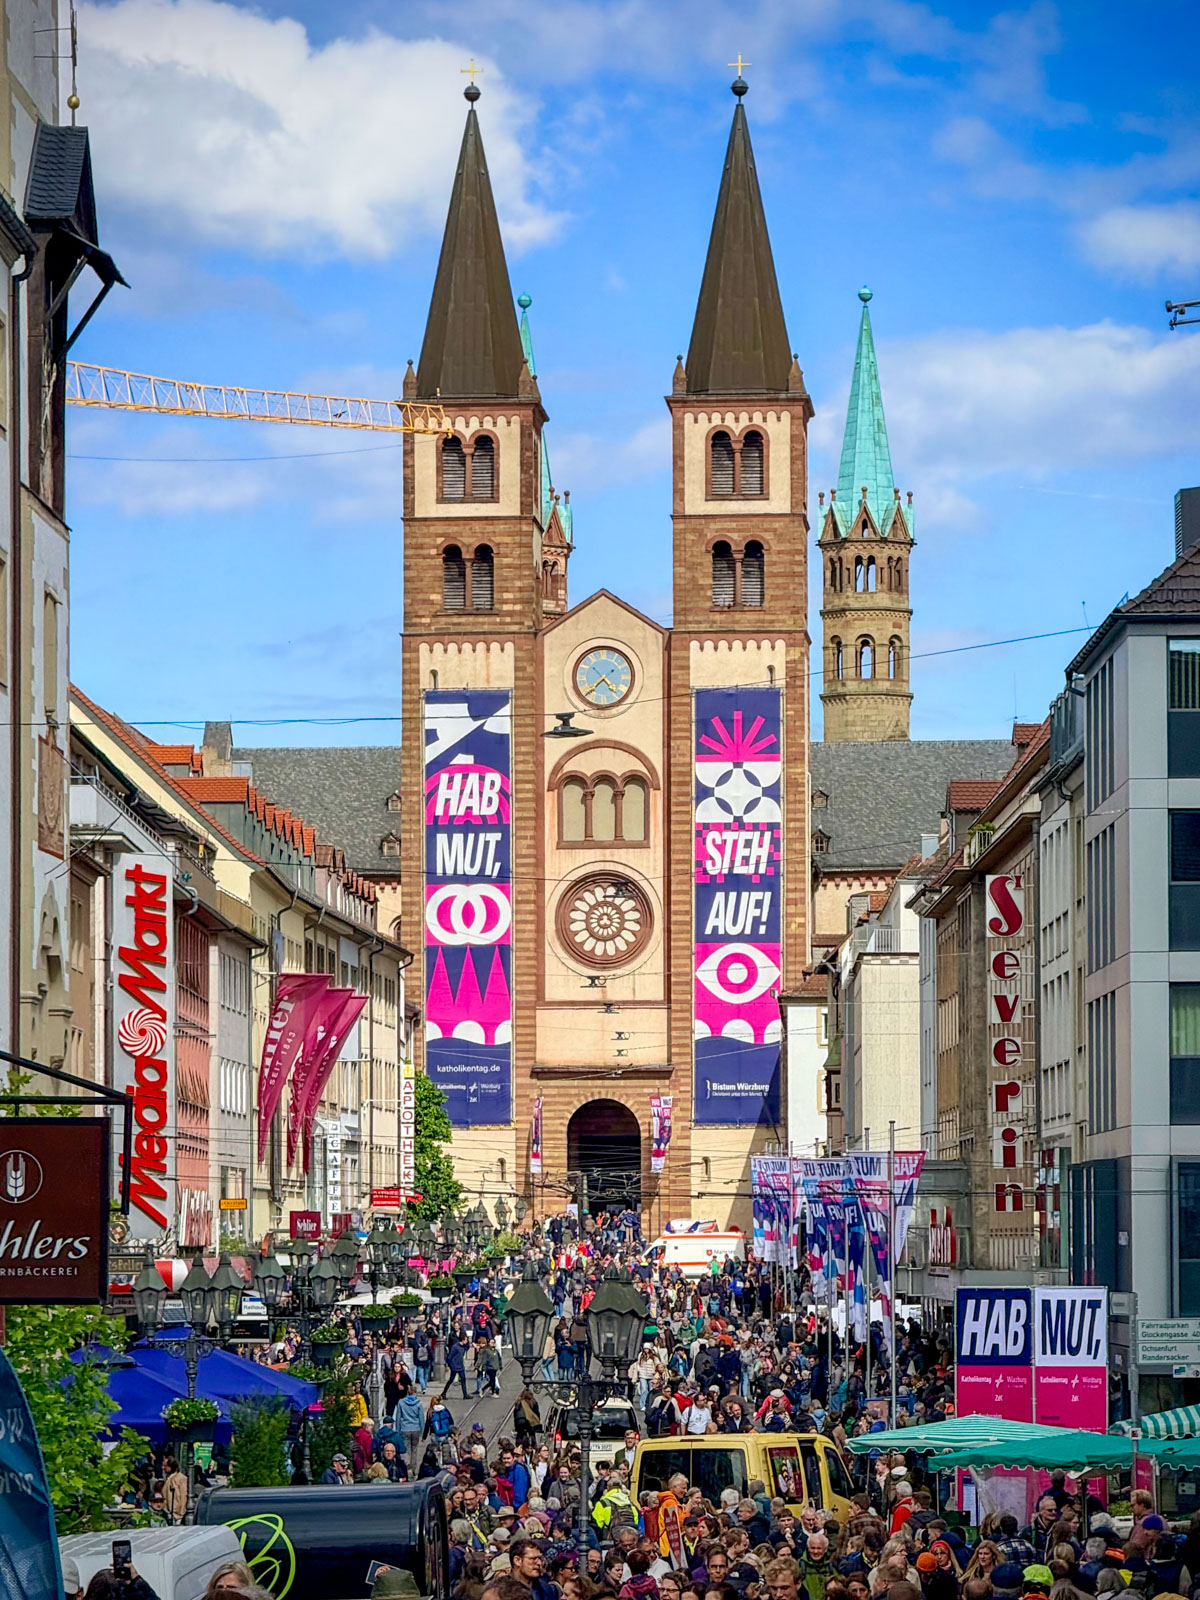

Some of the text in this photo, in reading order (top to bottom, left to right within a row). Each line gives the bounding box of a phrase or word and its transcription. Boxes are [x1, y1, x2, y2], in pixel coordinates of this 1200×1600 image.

[435, 772, 502, 816] HAB
[436, 832, 502, 878] MUT,
[705, 830, 772, 875] STEH
[704, 891, 772, 936] AUF!
[987, 874, 1024, 1212] Severin
[437, 1064, 501, 1074] katholikentag.de
[712, 1082, 770, 1092] Bistum Würzburg
[960, 1299, 1028, 1357] HAB
[1041, 1299, 1103, 1361] MUT,
[1141, 1321, 1190, 1330] Fahrradparken
[1141, 1331, 1189, 1339] Glockengasse
[1141, 1344, 1178, 1352] Ochsenfurt
[1141, 1353, 1190, 1362] Randersacker
